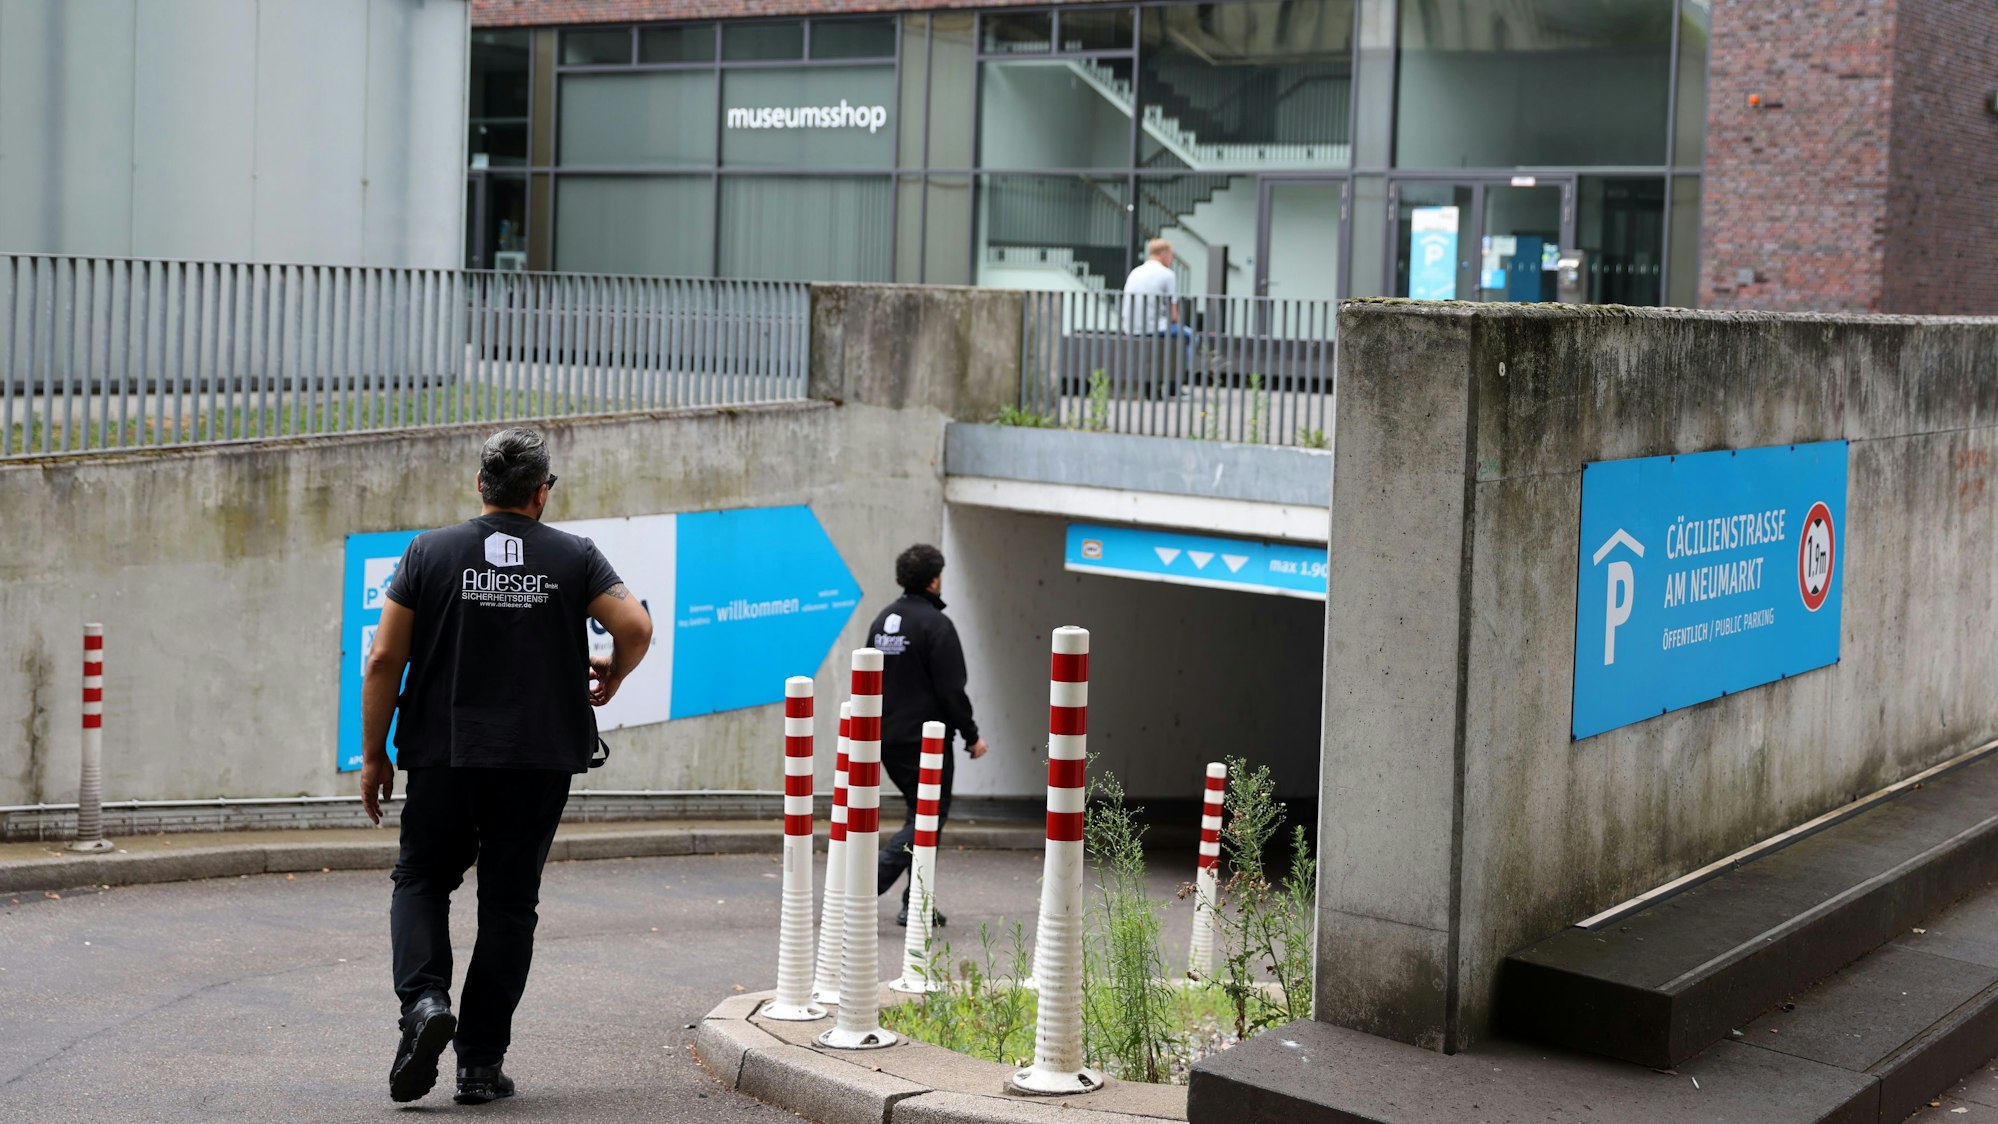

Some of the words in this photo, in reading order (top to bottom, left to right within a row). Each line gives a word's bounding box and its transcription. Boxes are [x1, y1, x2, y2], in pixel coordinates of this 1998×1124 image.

[727, 99, 887, 133] museumsshop
[1425, 244, 1444, 267] P
[1666, 508, 1786, 560] CÄCILIENSTRASSE
[1269, 560, 1297, 574] max
[462, 568, 548, 593] Adieser
[1664, 573, 1686, 609] AM
[1690, 557, 1764, 603] NEUMARKT
[461, 592, 549, 604] SICHERHEITSDIENST
[480, 601, 532, 609] www.adieser.de
[717, 597, 800, 622] willkommen
[1604, 560, 1635, 666] P
[1663, 622, 1708, 651] ÖFFENTLICH
[1715, 614, 1742, 638] PUBLIC
[1744, 607, 1775, 632] PARKING
